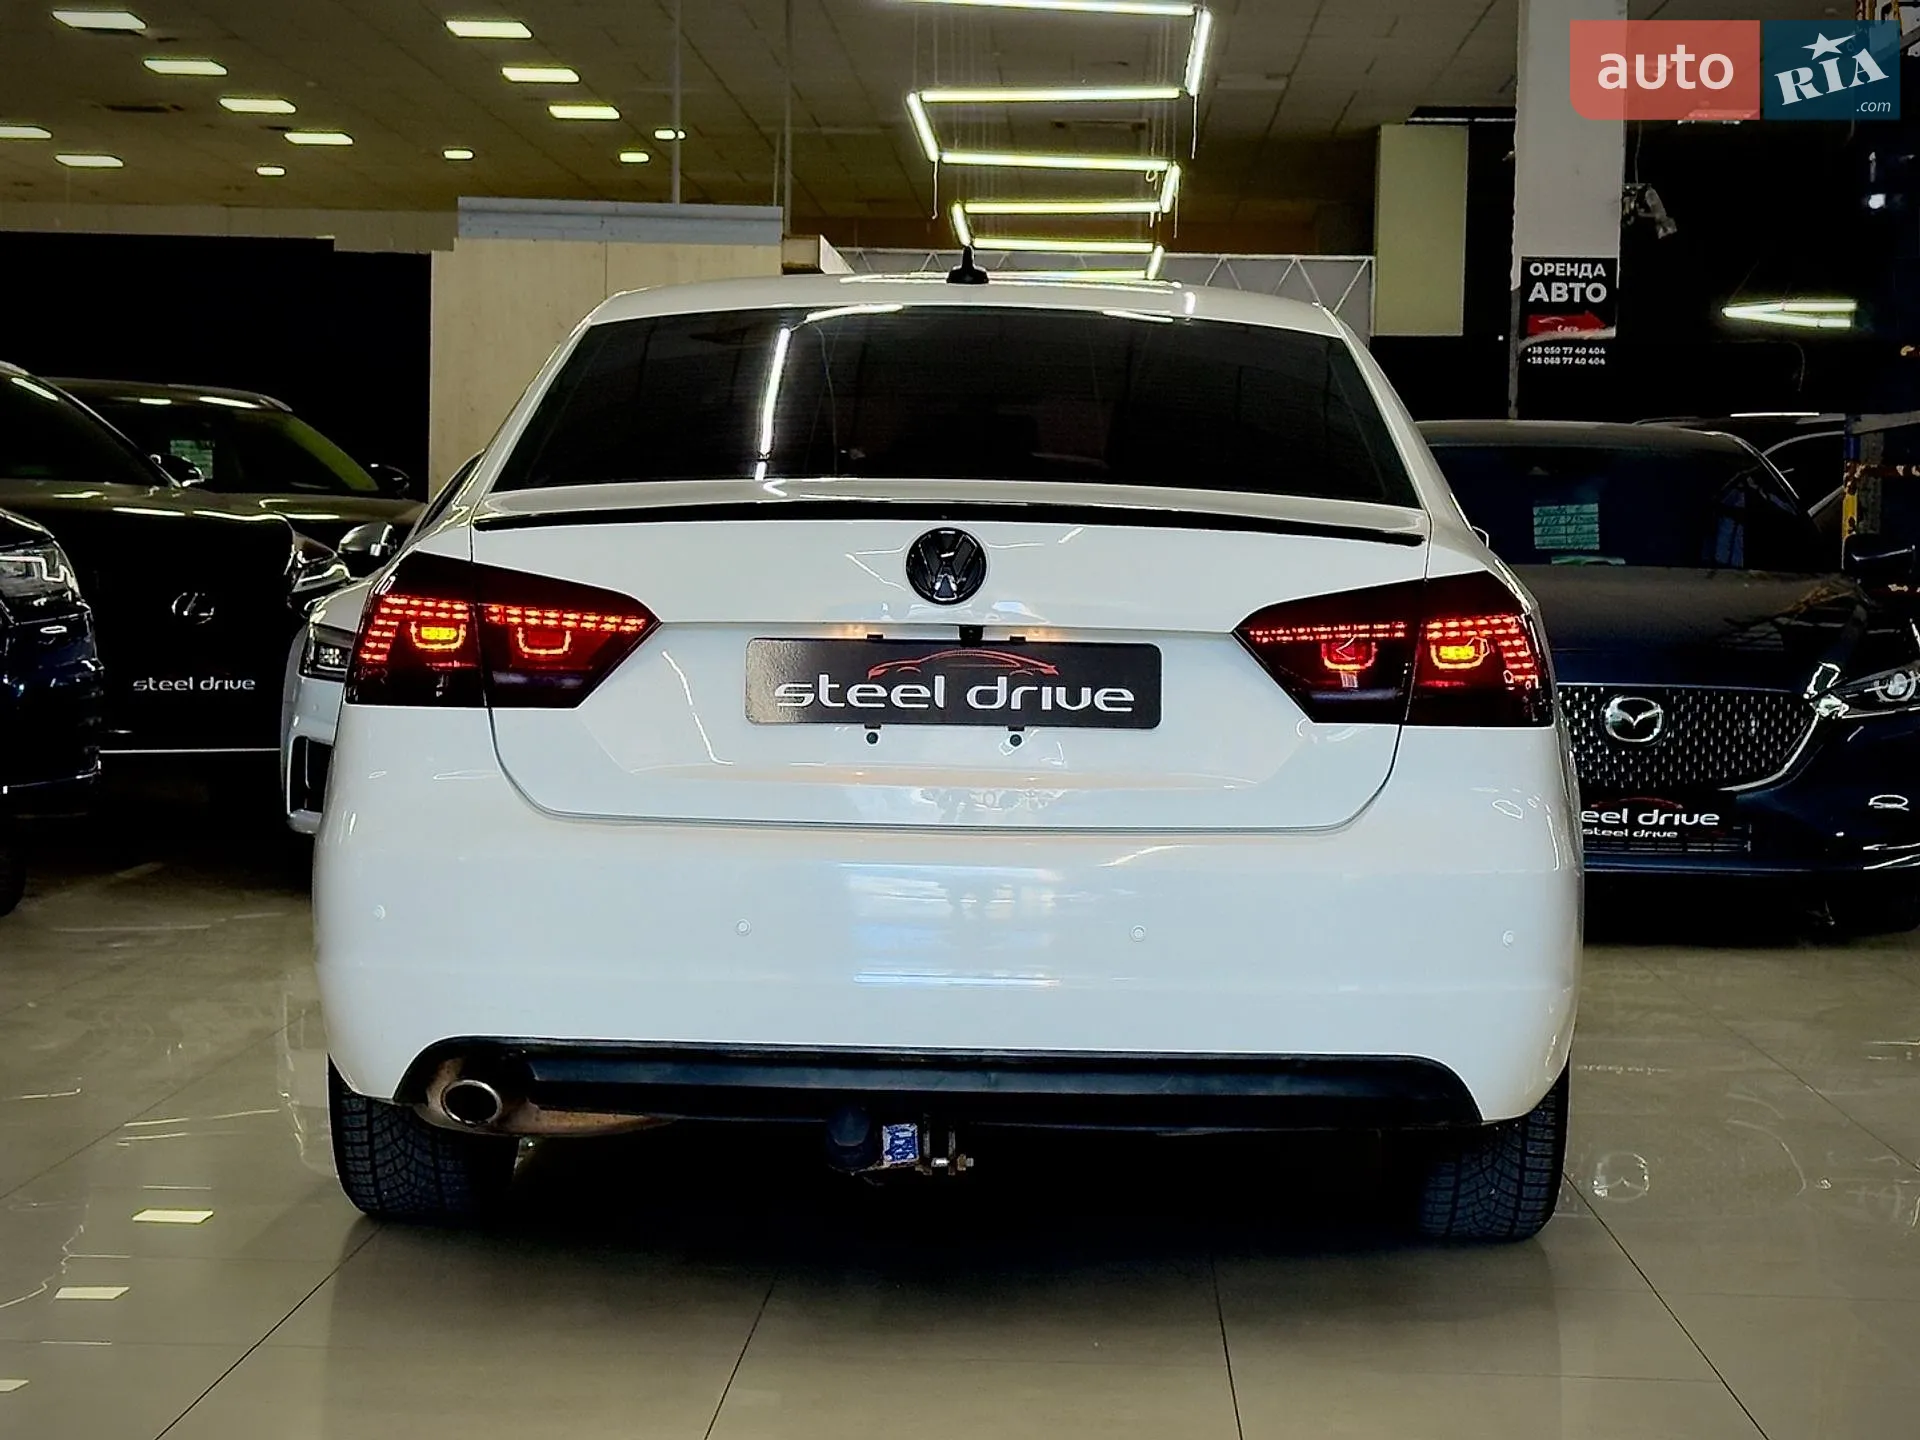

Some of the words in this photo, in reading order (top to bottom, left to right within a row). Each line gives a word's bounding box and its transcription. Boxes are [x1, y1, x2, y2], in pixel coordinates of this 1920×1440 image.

[1529, 262, 1606, 279] ОРЕНДА
[1528, 282, 1607, 303] АВТО
[132, 676, 193, 691] steel
[199, 676, 256, 691] drive
[774, 673, 944, 709] steel
[966, 675, 1135, 713] drive
[1581, 808, 1628, 824] eel
[1637, 809, 1720, 826] drive
[1582, 827, 1629, 838] steel
[1633, 829, 1678, 839] drive
